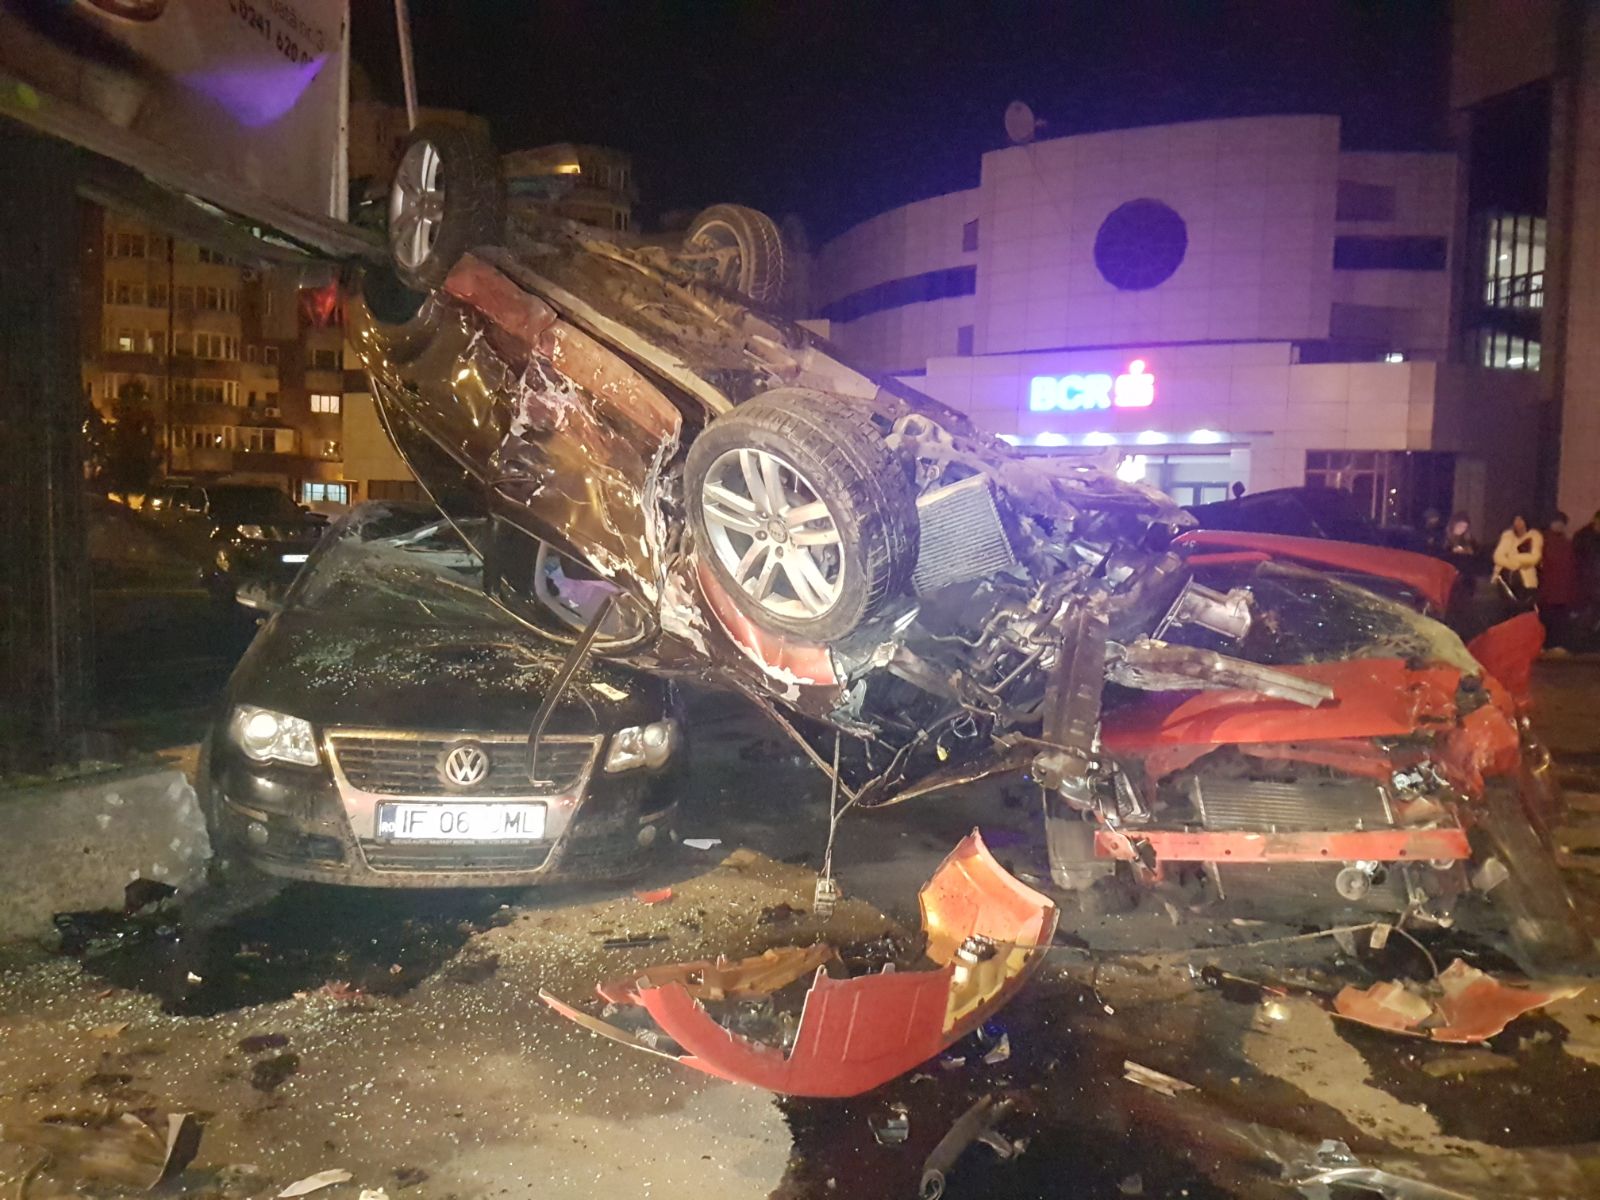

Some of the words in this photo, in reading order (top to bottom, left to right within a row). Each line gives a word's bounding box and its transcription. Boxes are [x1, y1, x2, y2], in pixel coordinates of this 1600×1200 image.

[276, 31, 299, 63] 620
[1030, 374, 1113, 411] BCR
[381, 822, 395, 832] RO
[402, 810, 428, 833] IF
[440, 811, 470, 833] 06
